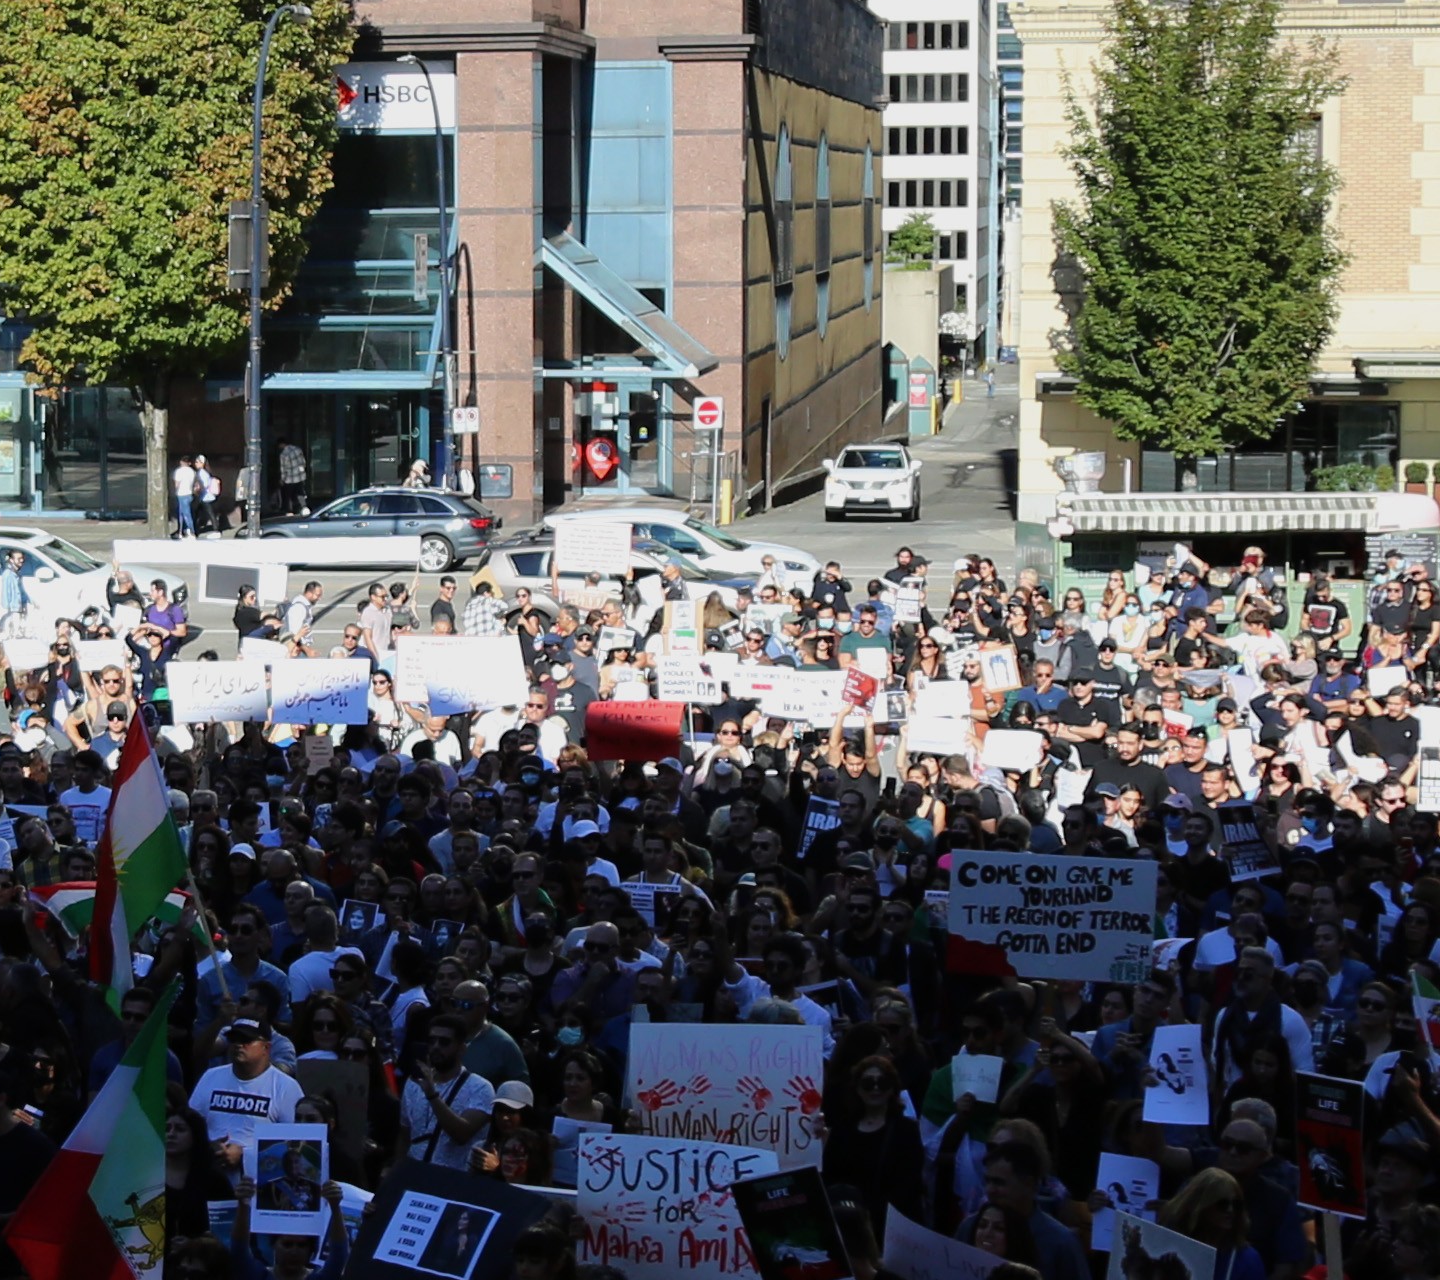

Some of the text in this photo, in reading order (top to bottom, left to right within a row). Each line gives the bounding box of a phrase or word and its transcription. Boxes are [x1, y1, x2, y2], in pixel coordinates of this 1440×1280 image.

[364, 85, 429, 104] HSBC
[958, 862, 1133, 887] COME ON GIVE ME
[963, 905, 1001, 924] THE
[1089, 911, 1152, 934] TERROR
[996, 930, 1095, 955] GOTTA END
[211, 1094, 235, 1109] JUST
[235, 1097, 252, 1110] DO
[1318, 1098, 1339, 1111] LIFE
[640, 1107, 811, 1155] HUMAN RIGHTS
[586, 1145, 761, 1194] JUSTICE
[767, 1188, 790, 1200] LIFE
[583, 1224, 663, 1266] Mahsa
